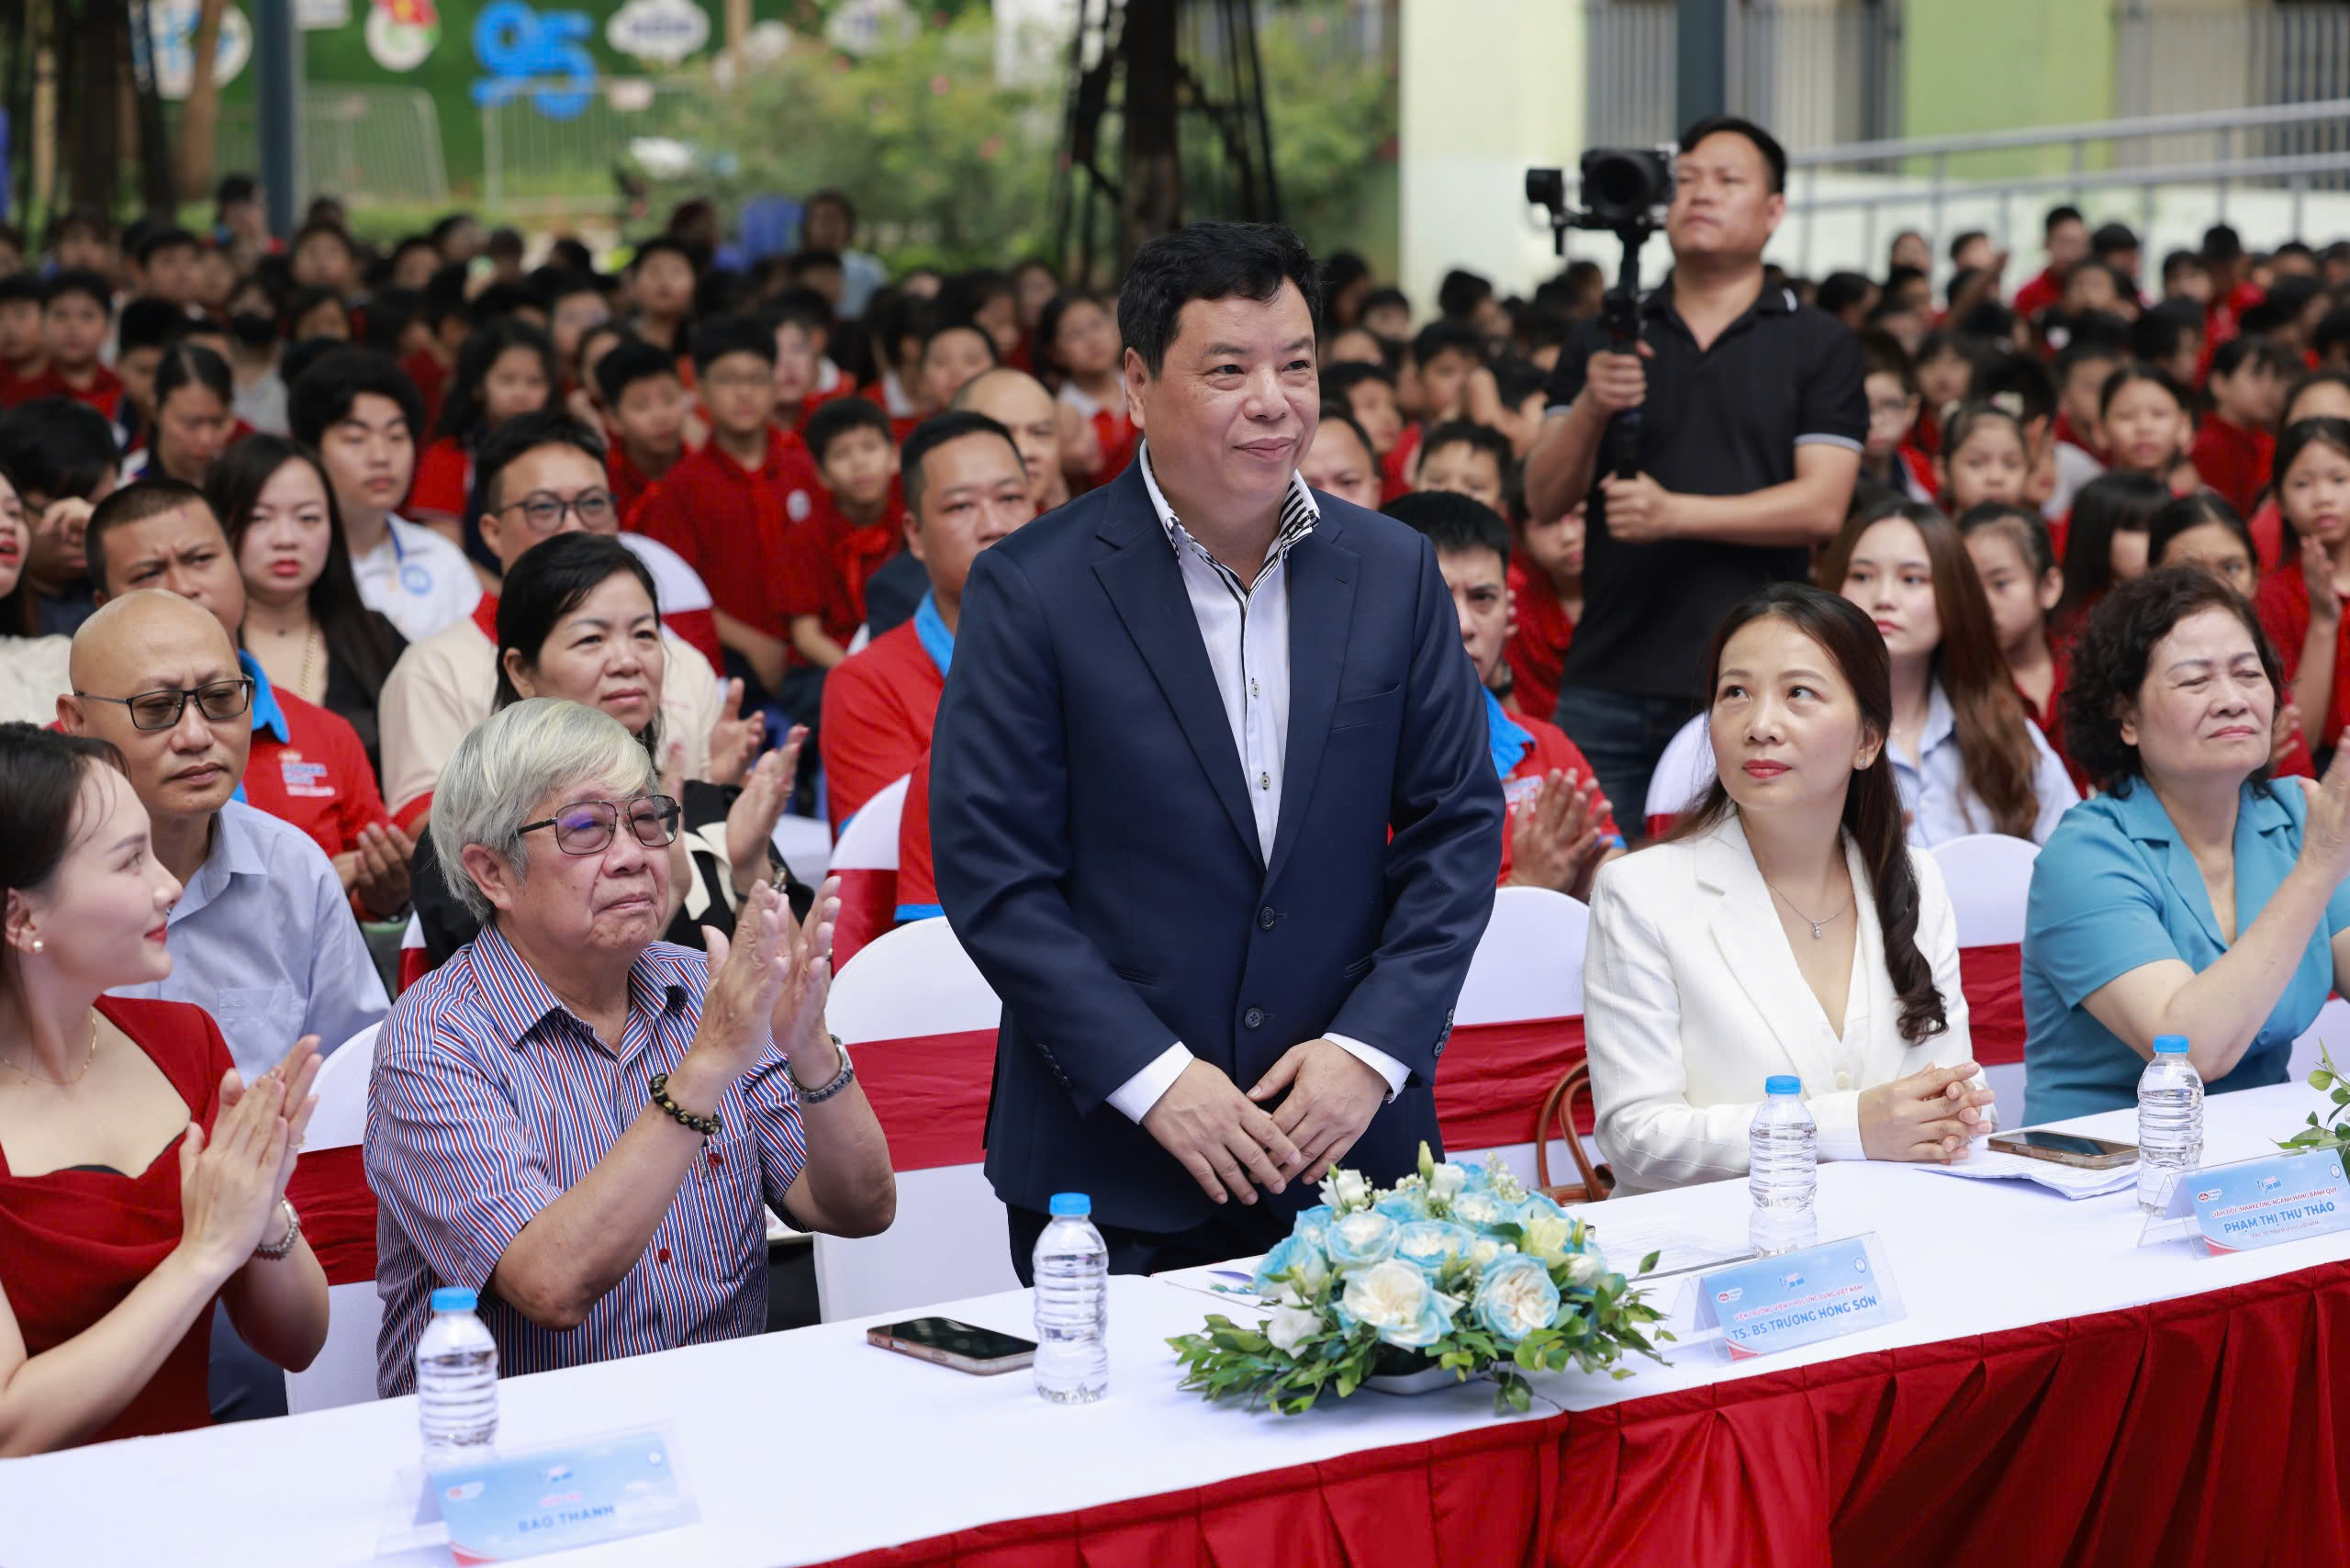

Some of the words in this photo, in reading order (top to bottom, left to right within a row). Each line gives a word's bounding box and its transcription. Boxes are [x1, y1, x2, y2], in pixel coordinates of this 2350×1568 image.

[2240, 1200, 2272, 1212] MARKETING
[2223, 1217, 2258, 1233] PHẠM
[2259, 1213, 2279, 1226] THỊ
[2279, 1207, 2302, 1222] THU
[1850, 1284, 1863, 1293] NAM
[1731, 1327, 1751, 1340] TS.
[1751, 1322, 1768, 1336] BS
[1769, 1310, 1817, 1331] TRƯƠNG
[1852, 1294, 1877, 1311] SƠN
